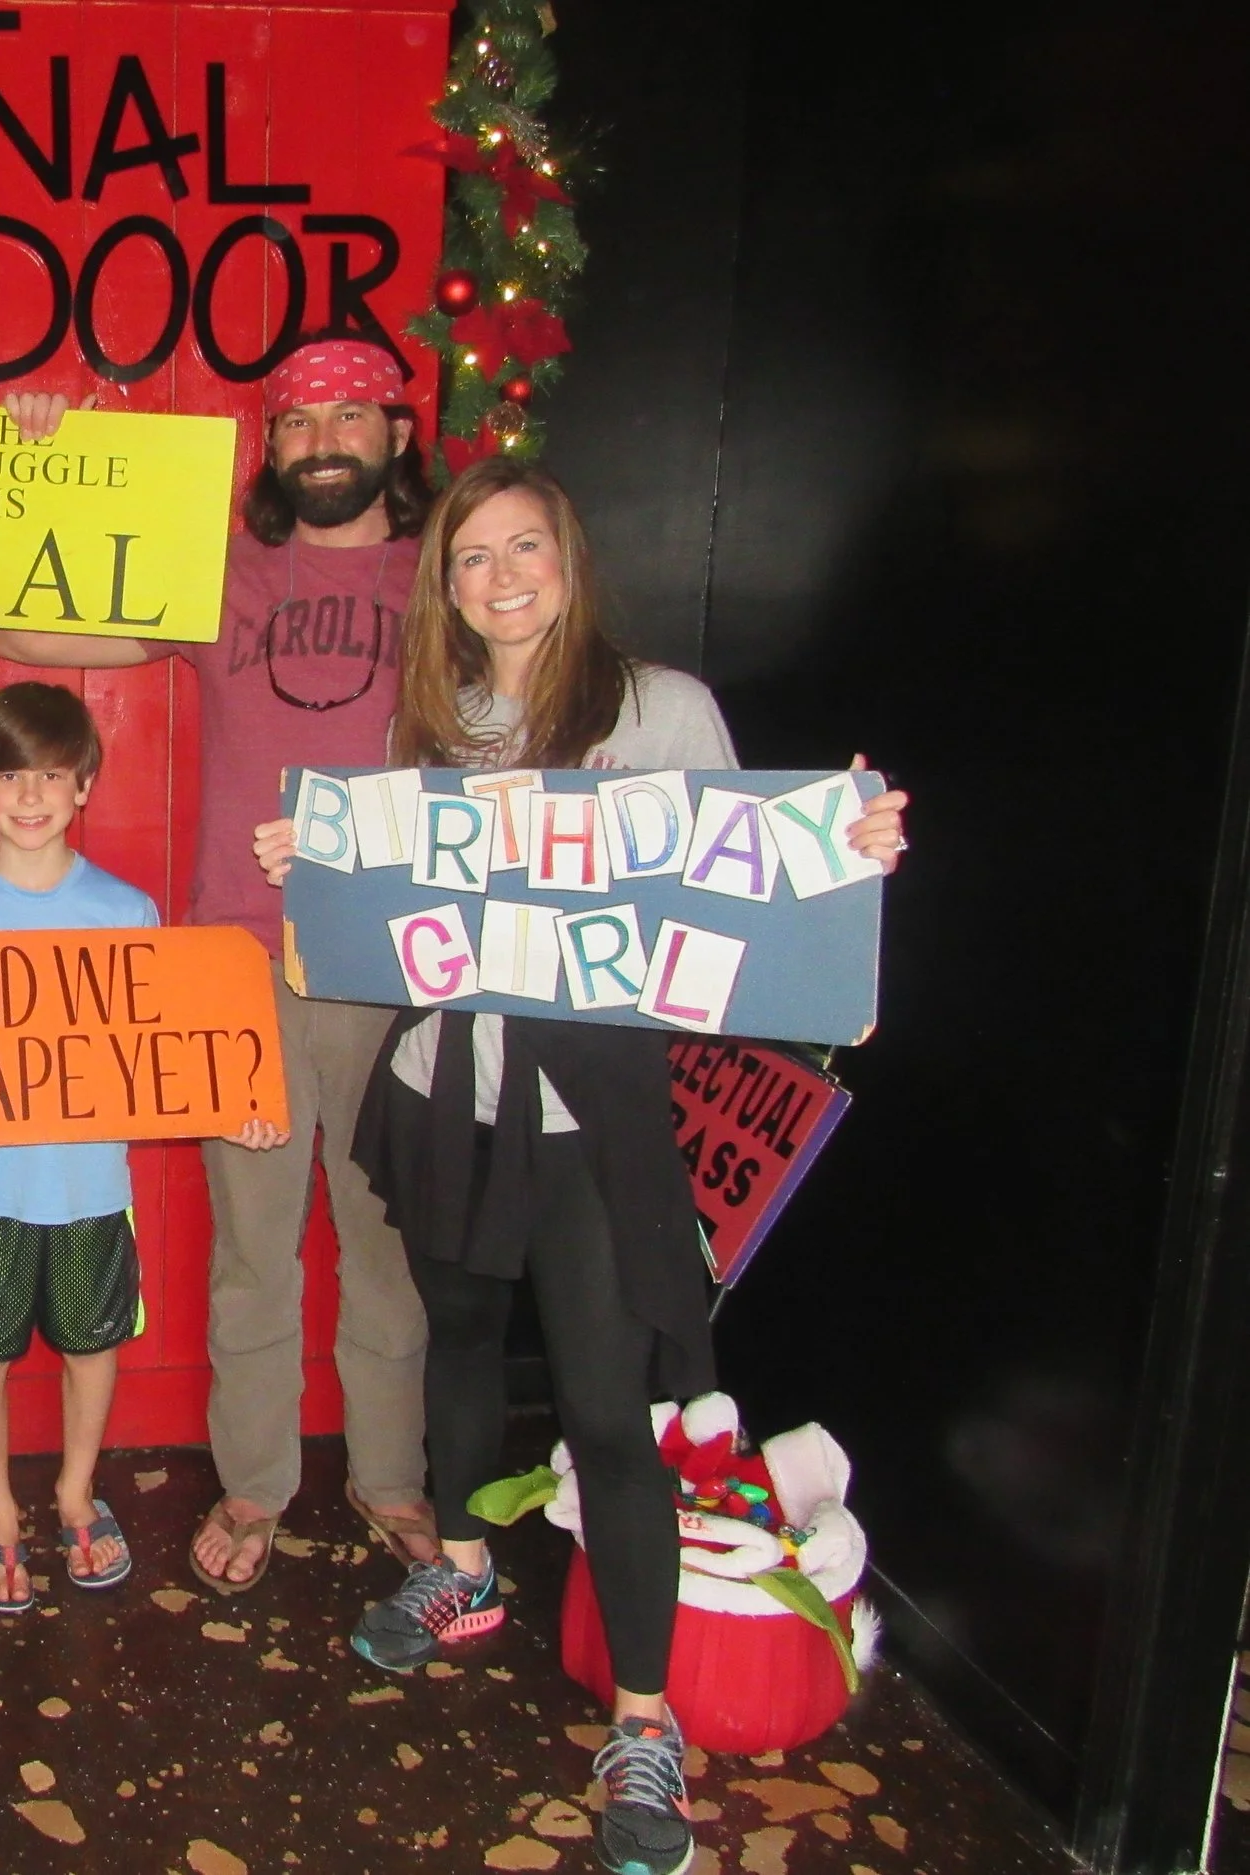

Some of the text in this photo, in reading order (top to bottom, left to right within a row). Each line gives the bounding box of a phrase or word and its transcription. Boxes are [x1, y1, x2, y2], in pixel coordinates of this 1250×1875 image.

[297, 776, 847, 896] BIRTHDAY
[53, 942, 162, 1026] WE
[402, 907, 710, 1023] GIRL
[108, 1027, 264, 1117] YET?
[667, 1037, 813, 1161] LECTUAL
